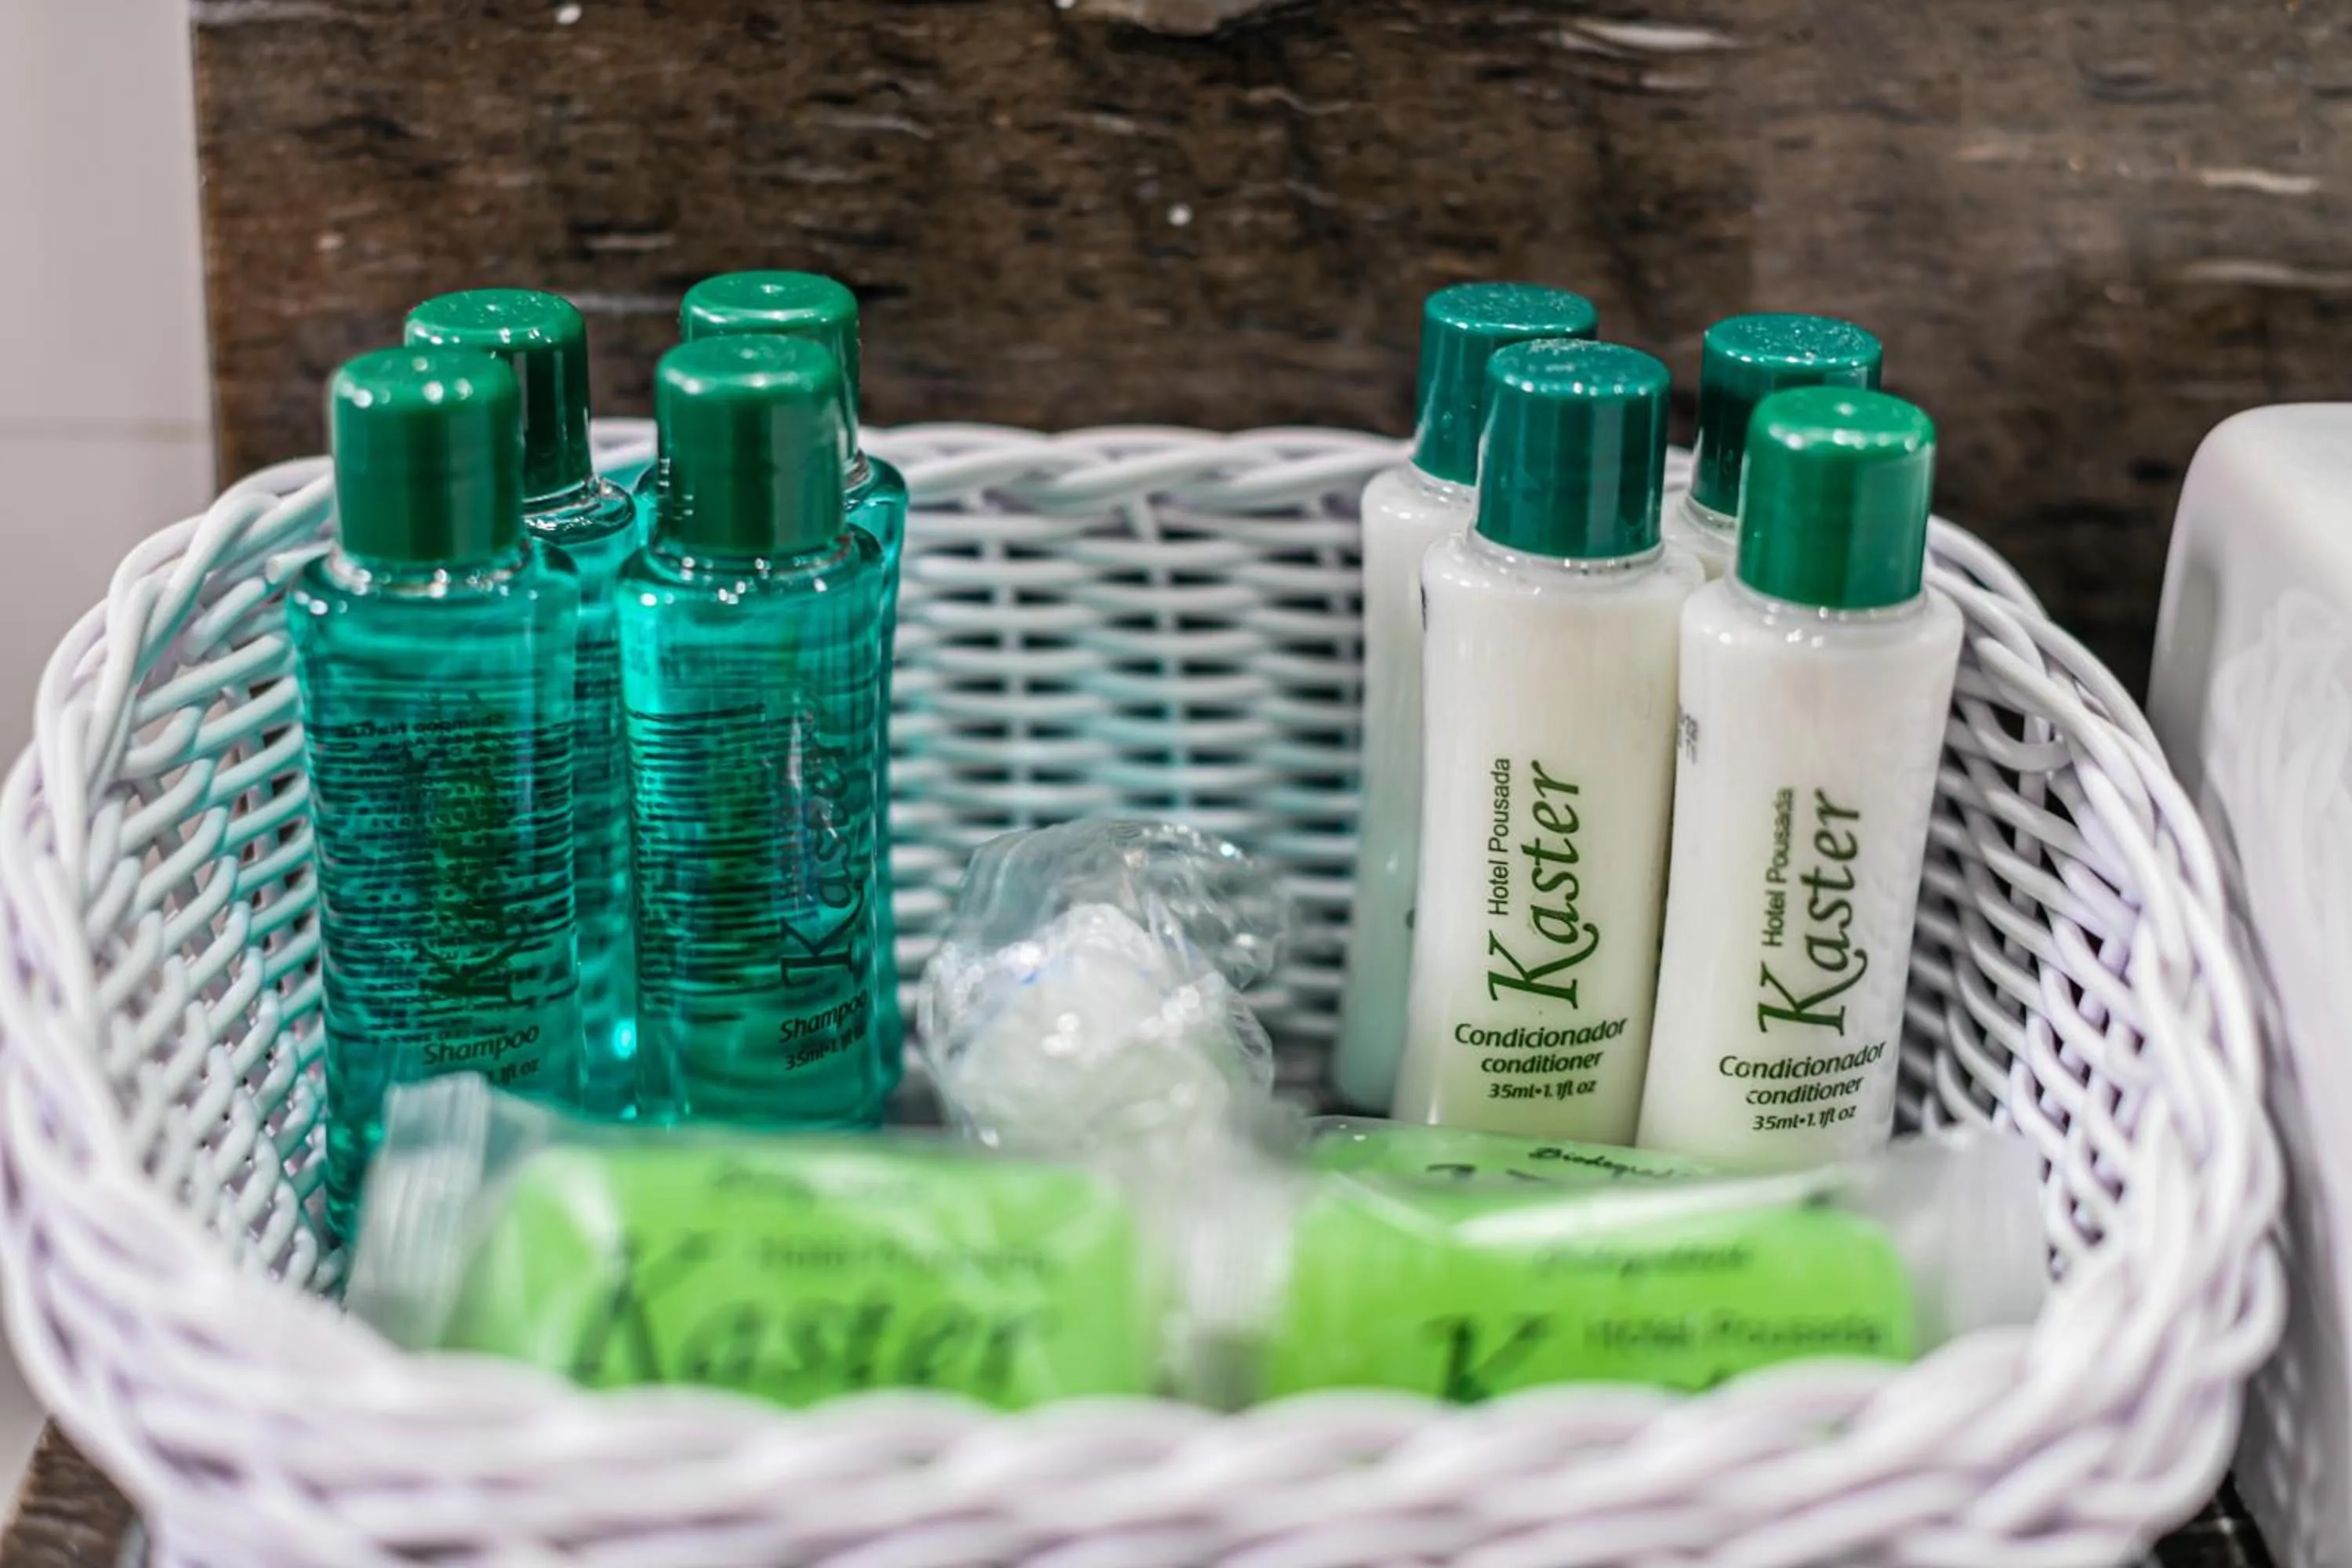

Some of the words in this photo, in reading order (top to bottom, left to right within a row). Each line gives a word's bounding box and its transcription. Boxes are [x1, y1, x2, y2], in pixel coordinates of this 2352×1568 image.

[1487, 757, 1511, 854] Pousada
[1766, 786, 1795, 885] Pousada
[1487, 759, 1600, 1010] Kaster
[1487, 860, 1509, 916] Hotel
[1757, 786, 1868, 1036] Kaster
[1762, 890, 1786, 948] Hotel
[779, 989, 868, 1044] Shampoo
[1454, 1018, 1628, 1049] Condicionador
[424, 1025, 540, 1065] Shampoo
[1480, 1051, 1604, 1074] conditioner
[1719, 1041, 1887, 1080] Condicionador
[1576, 1080, 1597, 1094] oz
[1745, 1076, 1864, 1105] conditioner
[1838, 1105, 1857, 1121] oz
